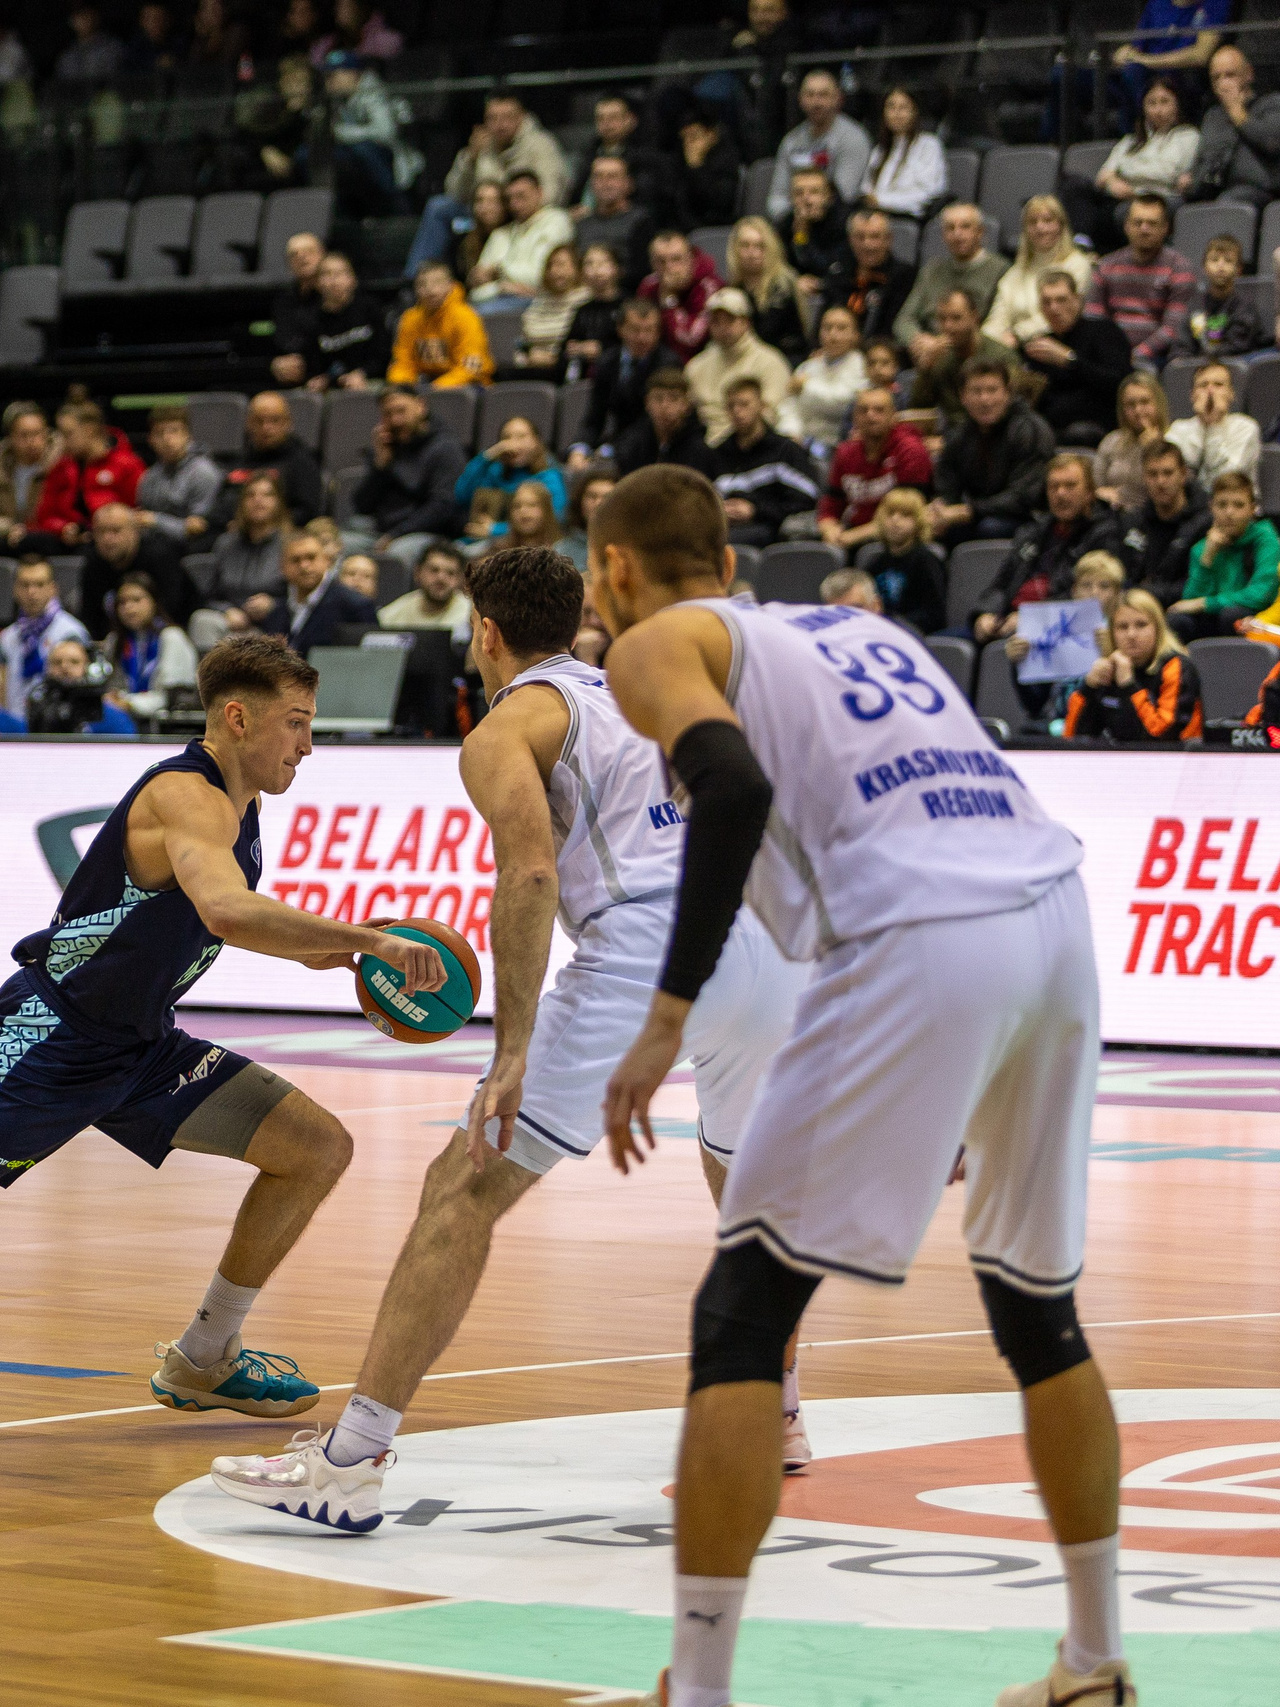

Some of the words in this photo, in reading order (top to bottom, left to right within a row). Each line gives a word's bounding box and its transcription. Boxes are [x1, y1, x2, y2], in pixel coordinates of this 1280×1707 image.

[816, 641, 946, 722] 33
[854, 746, 1026, 803] KRASNOYAR
[647, 800, 690, 830] KR
[920, 787, 1015, 819] REGION
[1136, 817, 1280, 892] BEL
[370, 969, 429, 1023] SIBUR
